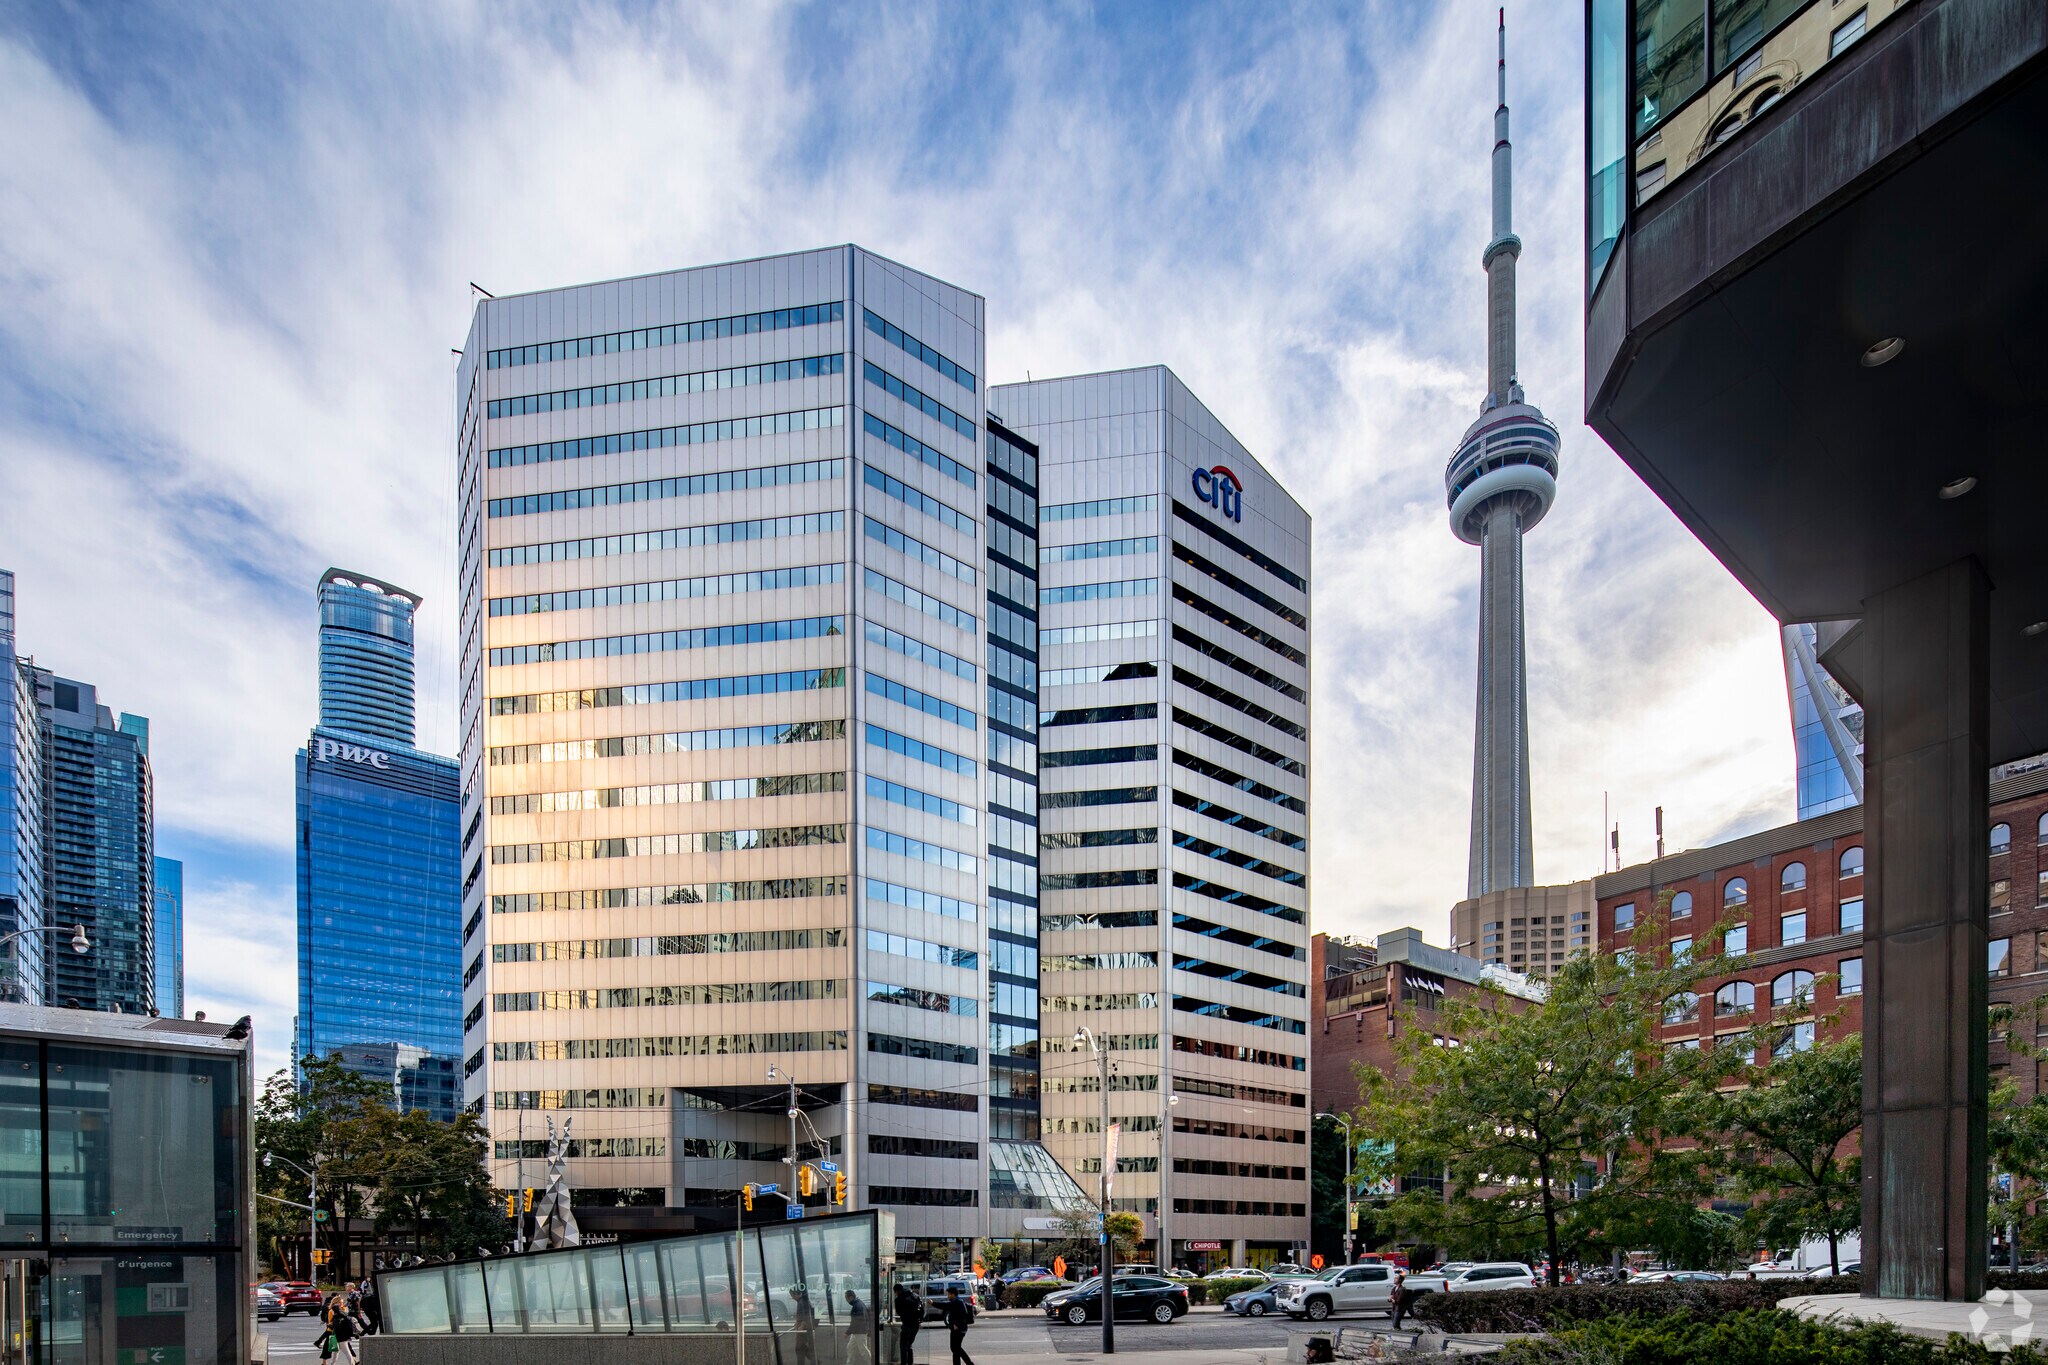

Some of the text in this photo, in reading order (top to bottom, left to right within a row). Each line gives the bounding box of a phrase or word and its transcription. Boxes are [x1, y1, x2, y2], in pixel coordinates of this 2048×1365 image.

[1192, 465, 1242, 523] citi
[315, 736, 390, 769] pwc
[118, 1231, 178, 1240] Emergency
[118, 1260, 172, 1268] d'urgence
